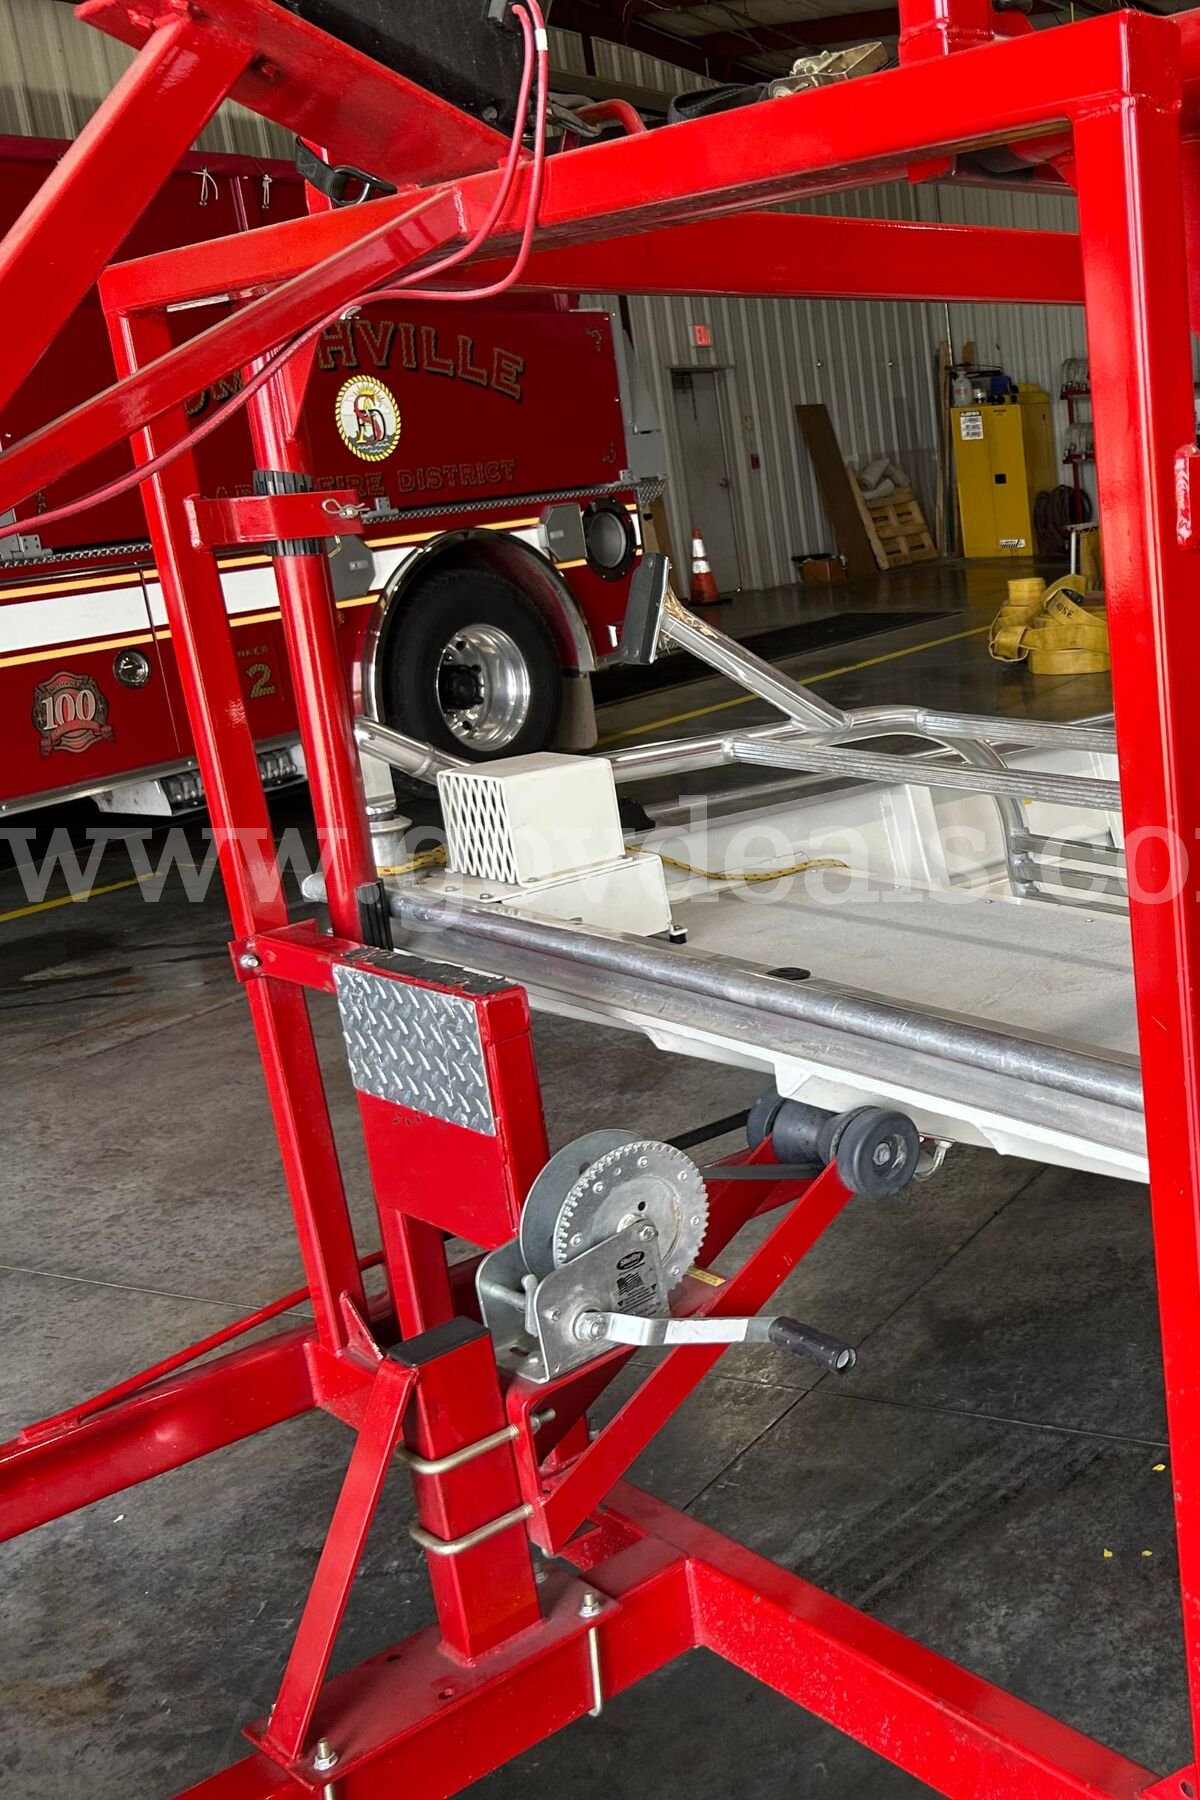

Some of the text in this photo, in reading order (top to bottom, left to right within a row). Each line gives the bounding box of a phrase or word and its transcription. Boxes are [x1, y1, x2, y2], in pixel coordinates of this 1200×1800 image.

[398, 459, 518, 493] DISTRICT
[246, 664, 276, 699] 2
[42, 690, 96, 731] 100
